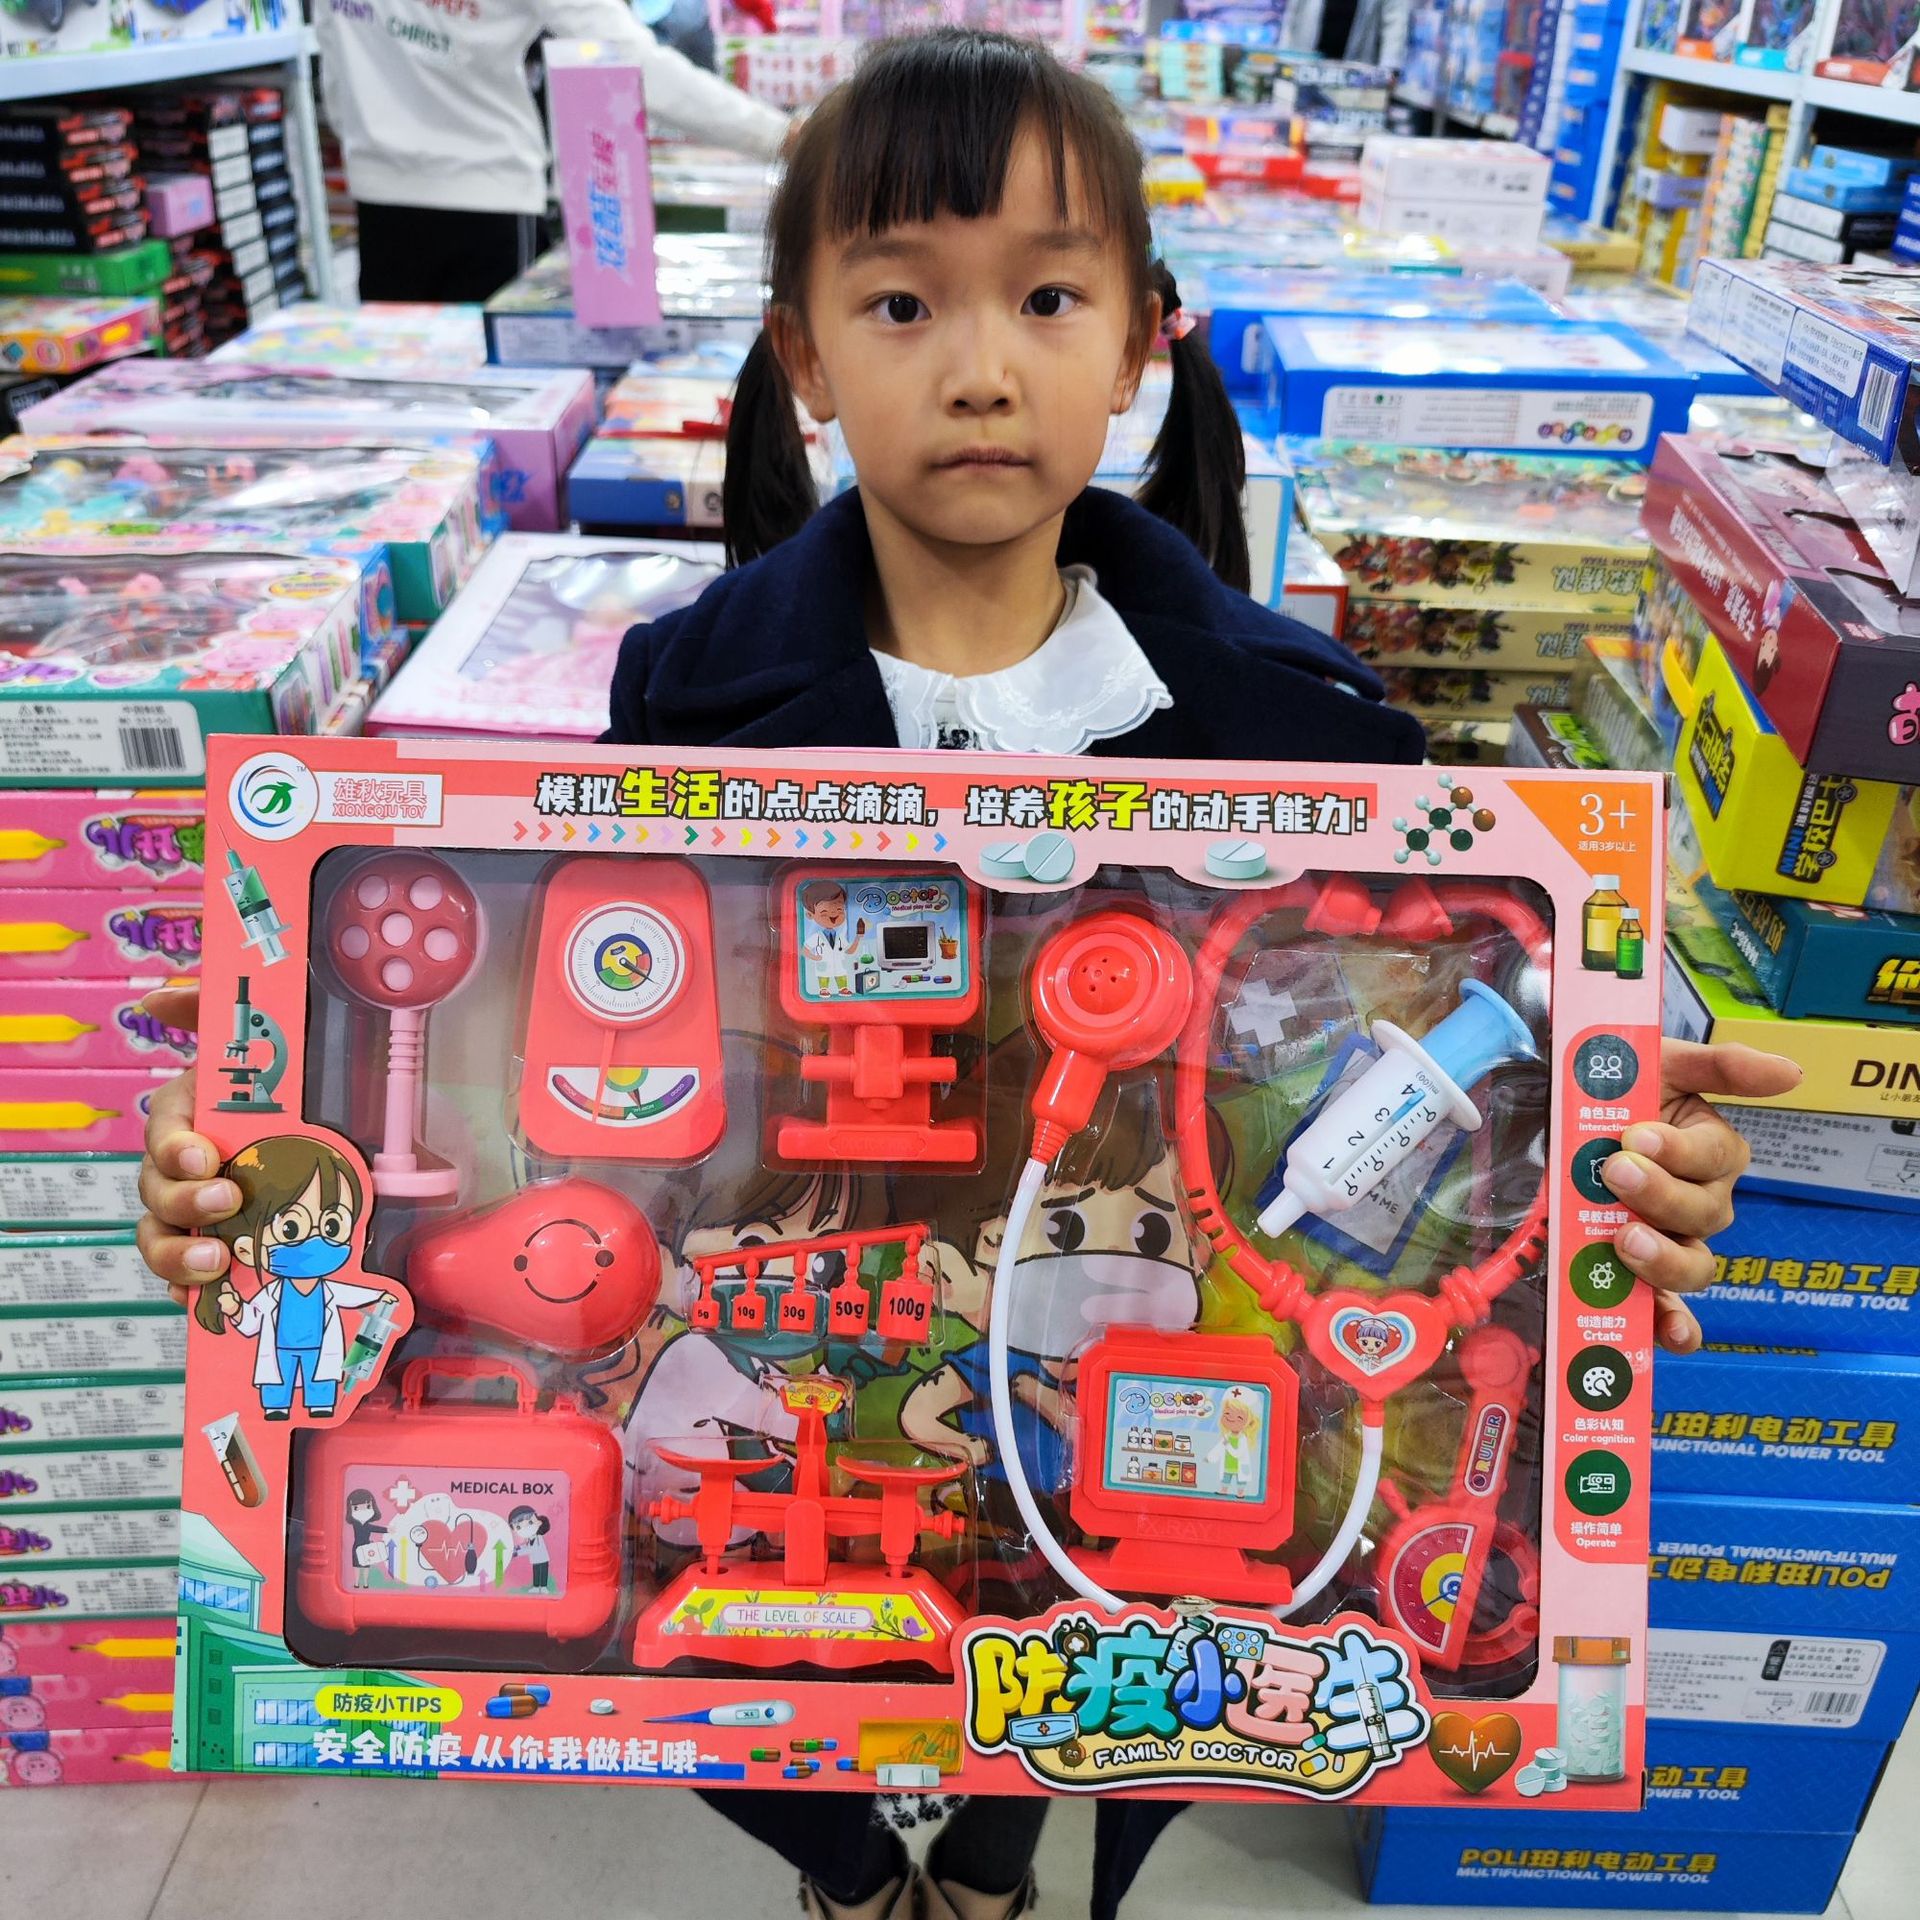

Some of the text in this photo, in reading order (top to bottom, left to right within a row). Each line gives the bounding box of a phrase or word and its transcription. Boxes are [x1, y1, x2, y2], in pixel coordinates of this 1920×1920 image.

[333, 778, 427, 804] 雄秋玩具
[332, 803, 427, 820] XIONGQIU TOY
[1579, 793, 1637, 836] 3+
[1578, 840, 1637, 853] 适用3岁以上
[856, 885, 941, 913] Doctor
[912, 903, 924, 912] play
[1401, 1082, 1417, 1096] 4
[1374, 1107, 1391, 1123] 3
[1579, 1106, 1630, 1120] 角色互动
[1578, 1121, 1629, 1132] Interactiv
[1347, 1130, 1365, 1147] 2
[1322, 1157, 1335, 1169] 1
[1577, 1210, 1629, 1224] 早教益智
[1584, 1226, 1619, 1237] Educat
[698, 1297, 925, 1321] 5g 10g 30g 50g 100g
[1781, 1290, 1854, 1308] POWER
[1860, 1295, 1911, 1312] TOOL
[1577, 1315, 1627, 1329] 创造能力
[1583, 1330, 1623, 1342] Crtate
[1119, 1386, 1204, 1414] Doctor
[1574, 1417, 1624, 1431] 色彩认知
[1476, 1414, 1501, 1473] RULER
[1562, 1433, 1636, 1445] Color cognition
[1762, 1444, 1832, 1461] POWER
[1837, 1448, 1885, 1463] TOOL
[450, 1481, 554, 1495] MEDICAL BOX
[1570, 1521, 1622, 1536] 操作简单
[1575, 1537, 1617, 1549] Operate
[1657, 1542, 1898, 1566] MULTIFUNCTIONAL POWER
[737, 1608, 857, 1624] THE LEVEL OF SCALE
[970, 1623, 1424, 1754] 防疫小医生
[333, 1693, 442, 1714] 防疫小TIPS
[313, 1728, 462, 1767] 安全防疫
[1095, 1740, 1296, 1772] FAMILY DOCTOR
[1697, 1789, 1740, 1801] TOOL
[1460, 1849, 1718, 1873] POLI珀利电动工具
[1456, 1867, 1709, 1884] MULTIFUNCTIONAL POWER TOOL
